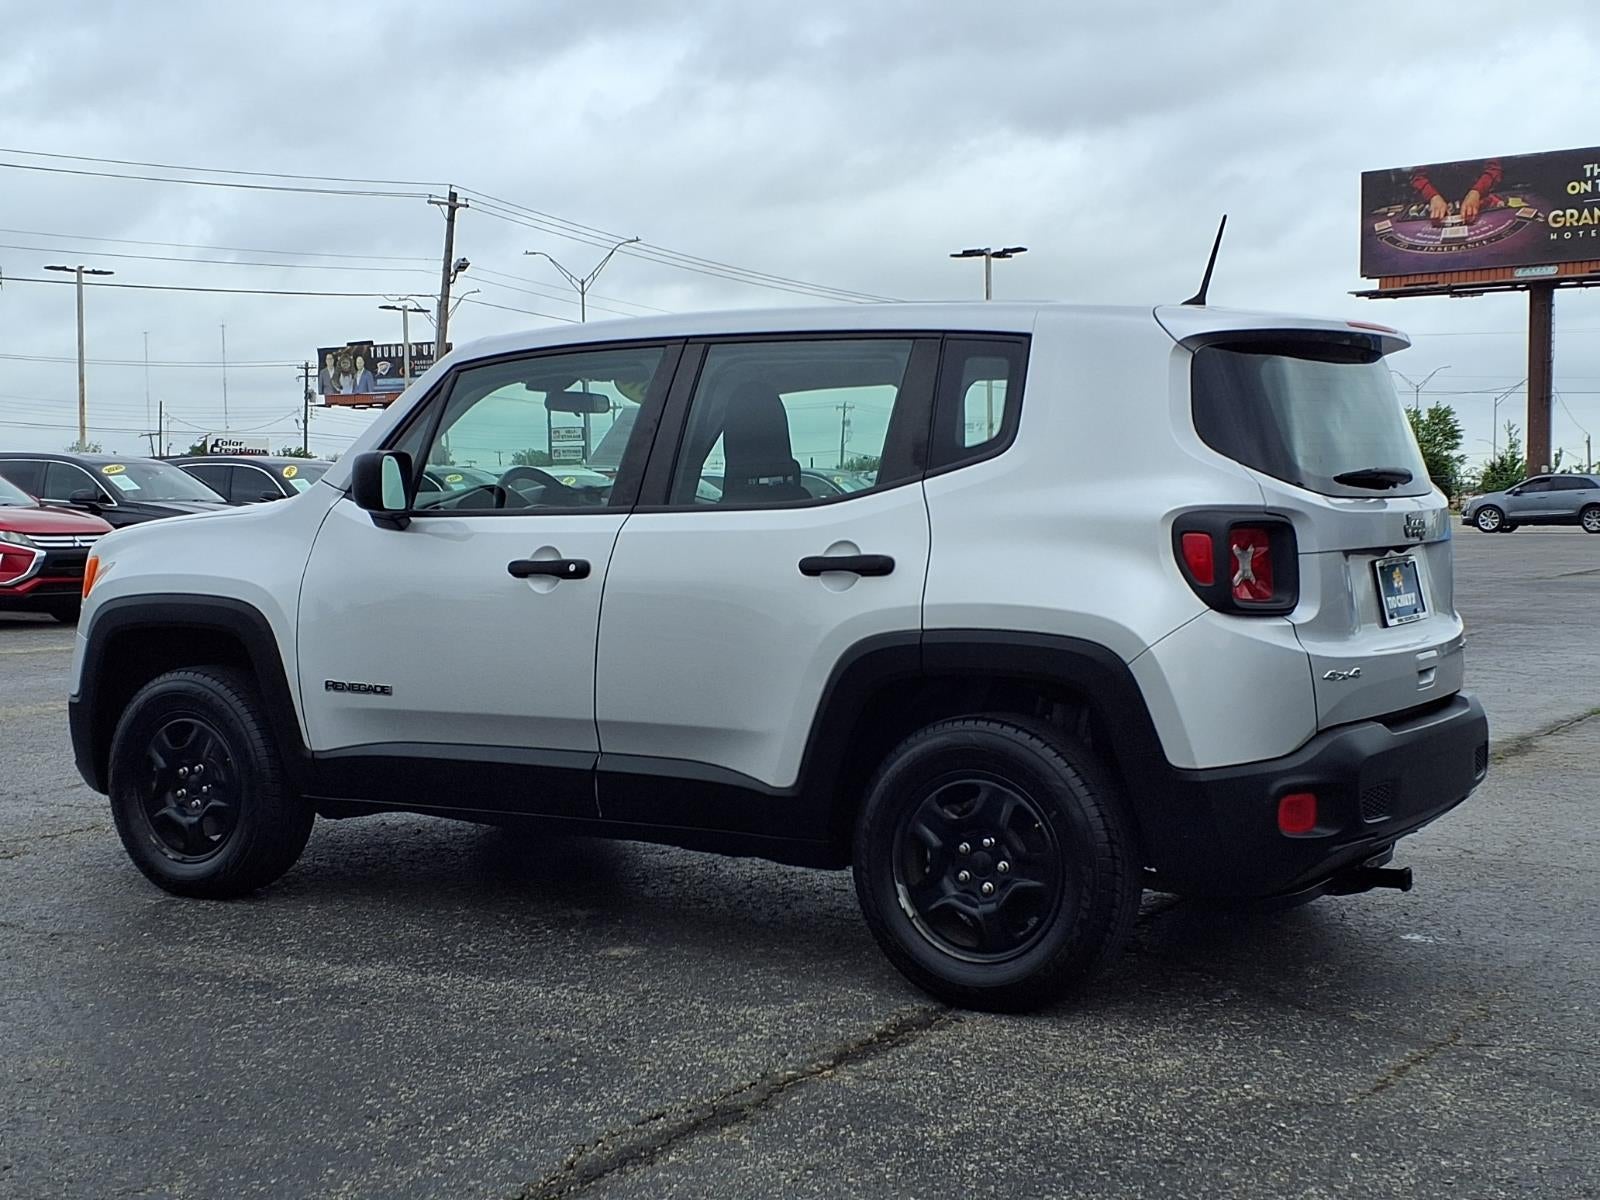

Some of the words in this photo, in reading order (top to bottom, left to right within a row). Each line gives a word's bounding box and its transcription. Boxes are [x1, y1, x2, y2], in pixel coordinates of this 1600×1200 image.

[1567, 181, 1592, 195] ON
[1550, 229, 1597, 240] HOTE
[370, 345, 416, 358] THUNDR
[210, 443, 268, 454] Creations
[215, 438, 244, 447] Color
[1322, 667, 1361, 681] 4x4
[325, 680, 392, 696] RENEGADE
